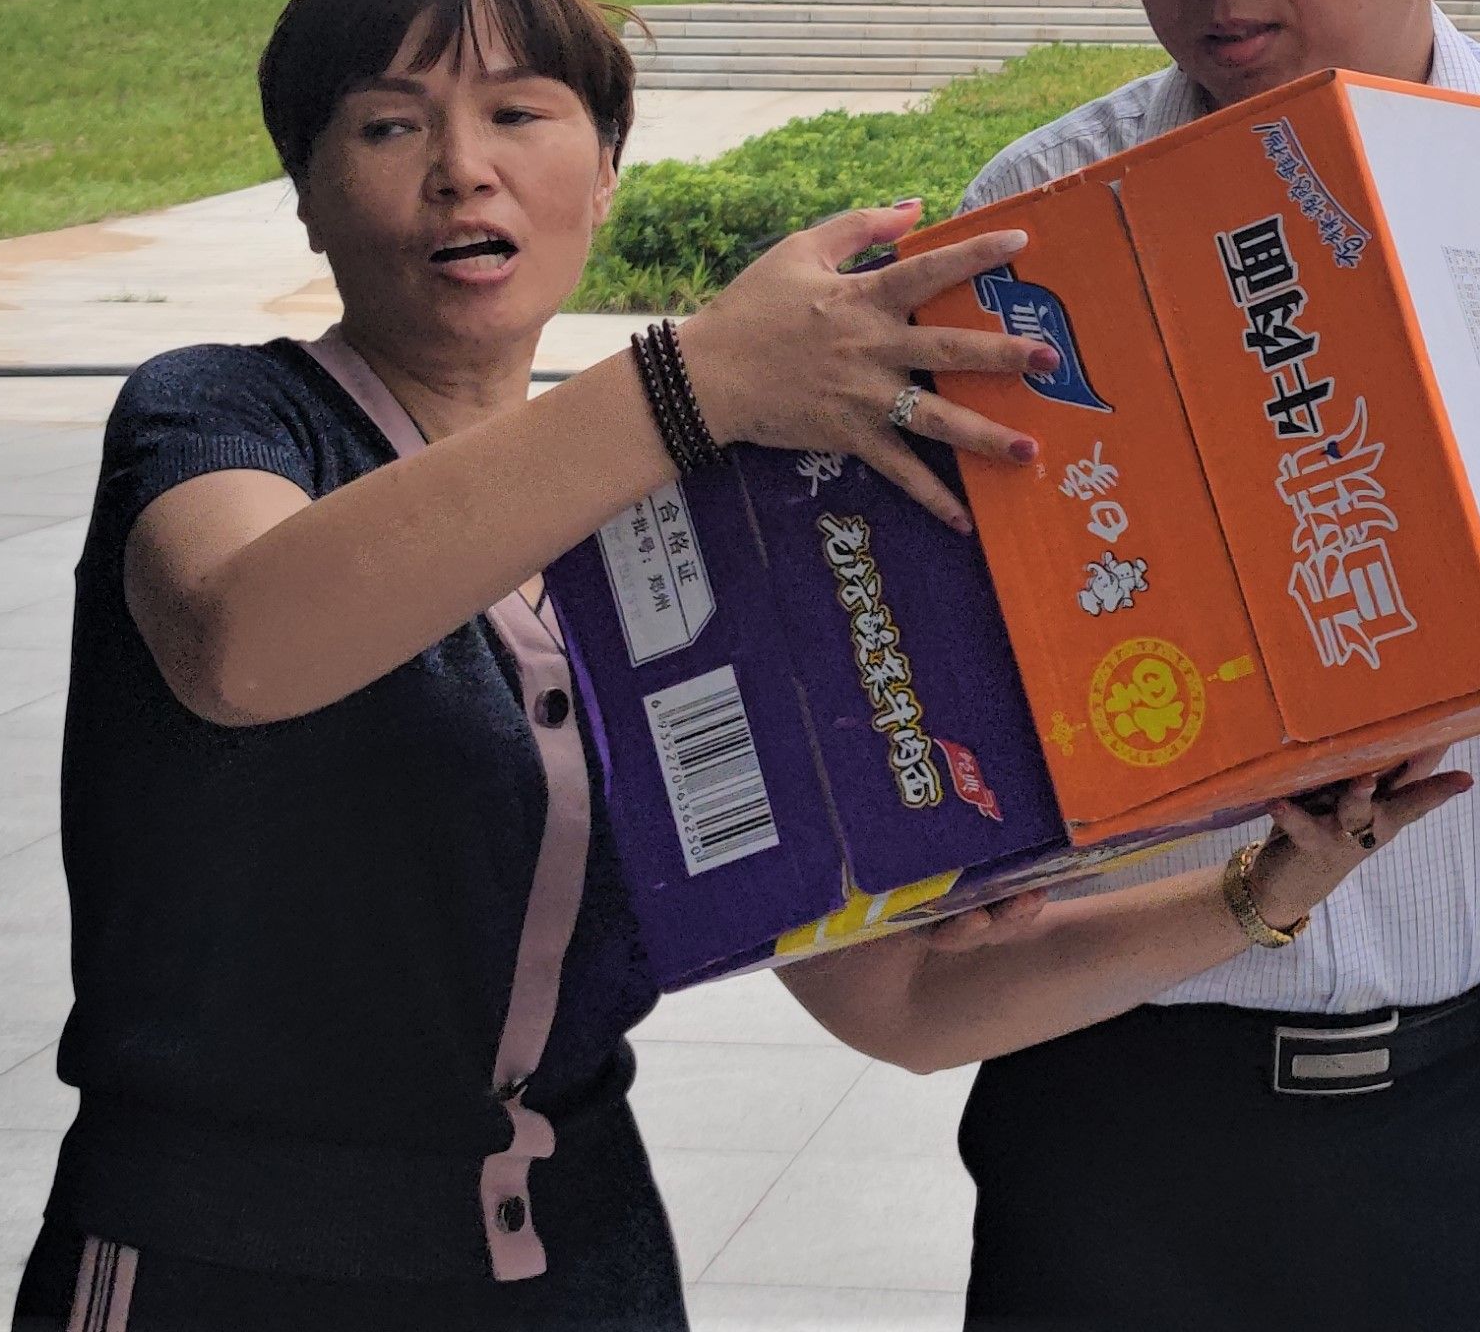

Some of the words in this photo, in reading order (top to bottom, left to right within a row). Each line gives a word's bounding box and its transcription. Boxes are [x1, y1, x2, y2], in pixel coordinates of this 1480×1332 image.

[658, 500, 699, 587] 合格证
[1215, 213, 1418, 671] 香辣牛肉面
[819, 513, 944, 808] 老坛酸菜牛肉面
